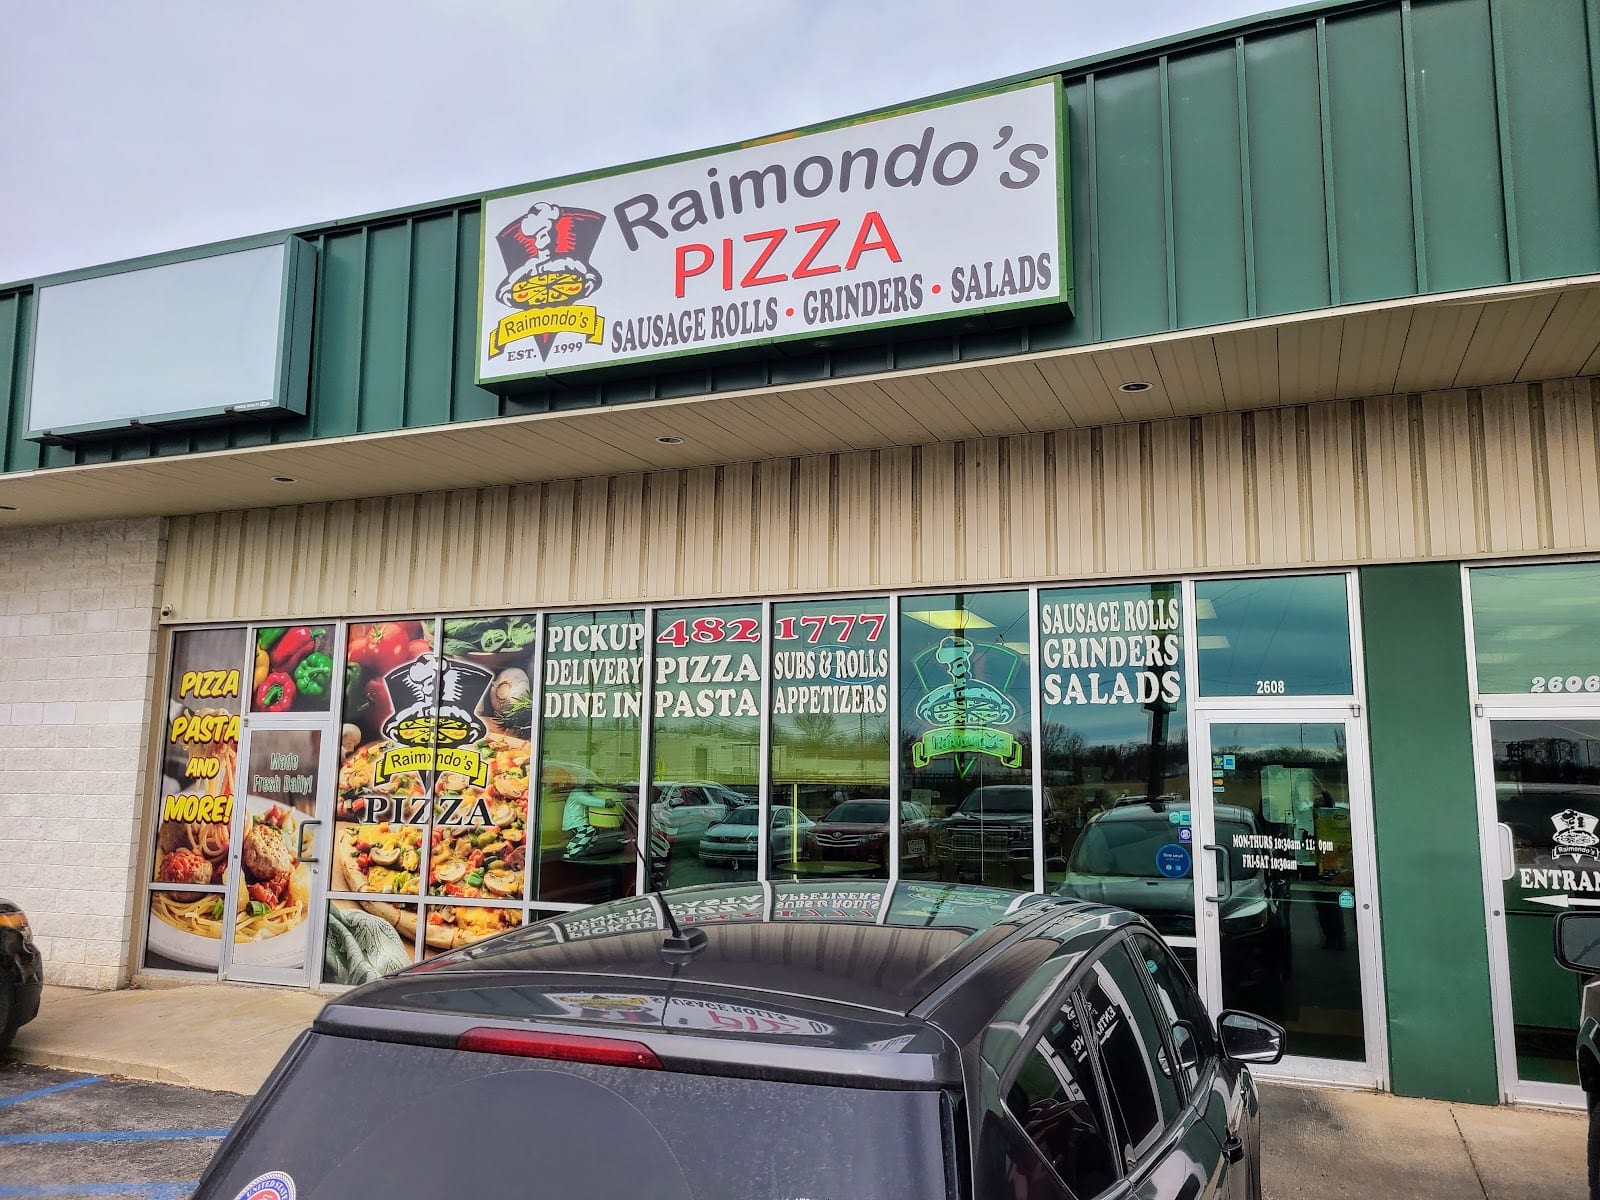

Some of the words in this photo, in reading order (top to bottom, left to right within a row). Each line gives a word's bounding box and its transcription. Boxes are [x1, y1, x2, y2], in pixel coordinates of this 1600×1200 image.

[613, 125, 1049, 252] Raimondo's
[674, 211, 903, 298] PIZZA
[611, 309, 706, 354] SAUSAGE
[710, 297, 778, 340] ROLLS
[803, 273, 923, 326] GRINDERS
[951, 252, 1052, 302] SALADS
[504, 309, 589, 337] Raimondo's
[507, 348, 536, 362] EST.
[553, 342, 583, 354] 1999
[656, 617, 761, 647] 482
[774, 614, 887, 643] 1777
[1042, 600, 1120, 635] SAUSAGE
[1123, 598, 1179, 632] ROLLS
[547, 623, 645, 652] PICKUP
[1043, 634, 1179, 669] GRINDERS
[545, 657, 644, 686] DELIVERY
[656, 653, 760, 684] PIZZA
[774, 650, 816, 680] SUBS
[819, 650, 832, 679] &
[836, 648, 888, 679] ROLLS
[180, 669, 240, 699] PIZZA
[773, 684, 887, 714] APPETIZERS
[1043, 670, 1180, 705] SALADS
[1256, 680, 1285, 694] 2608
[1531, 675, 1600, 693] 2606
[544, 691, 607, 718] DINE
[613, 691, 642, 718] IN
[655, 688, 760, 718] PASTA
[170, 714, 241, 745] PASTA
[185, 757, 220, 779] AND
[271, 752, 299, 770] Made
[253, 774, 281, 792] Fresh
[283, 774, 313, 795] Daily!
[163, 794, 234, 825] MORE!
[364, 797, 496, 826] PIZZA
[246, 1179, 275, 1198] UNITED
